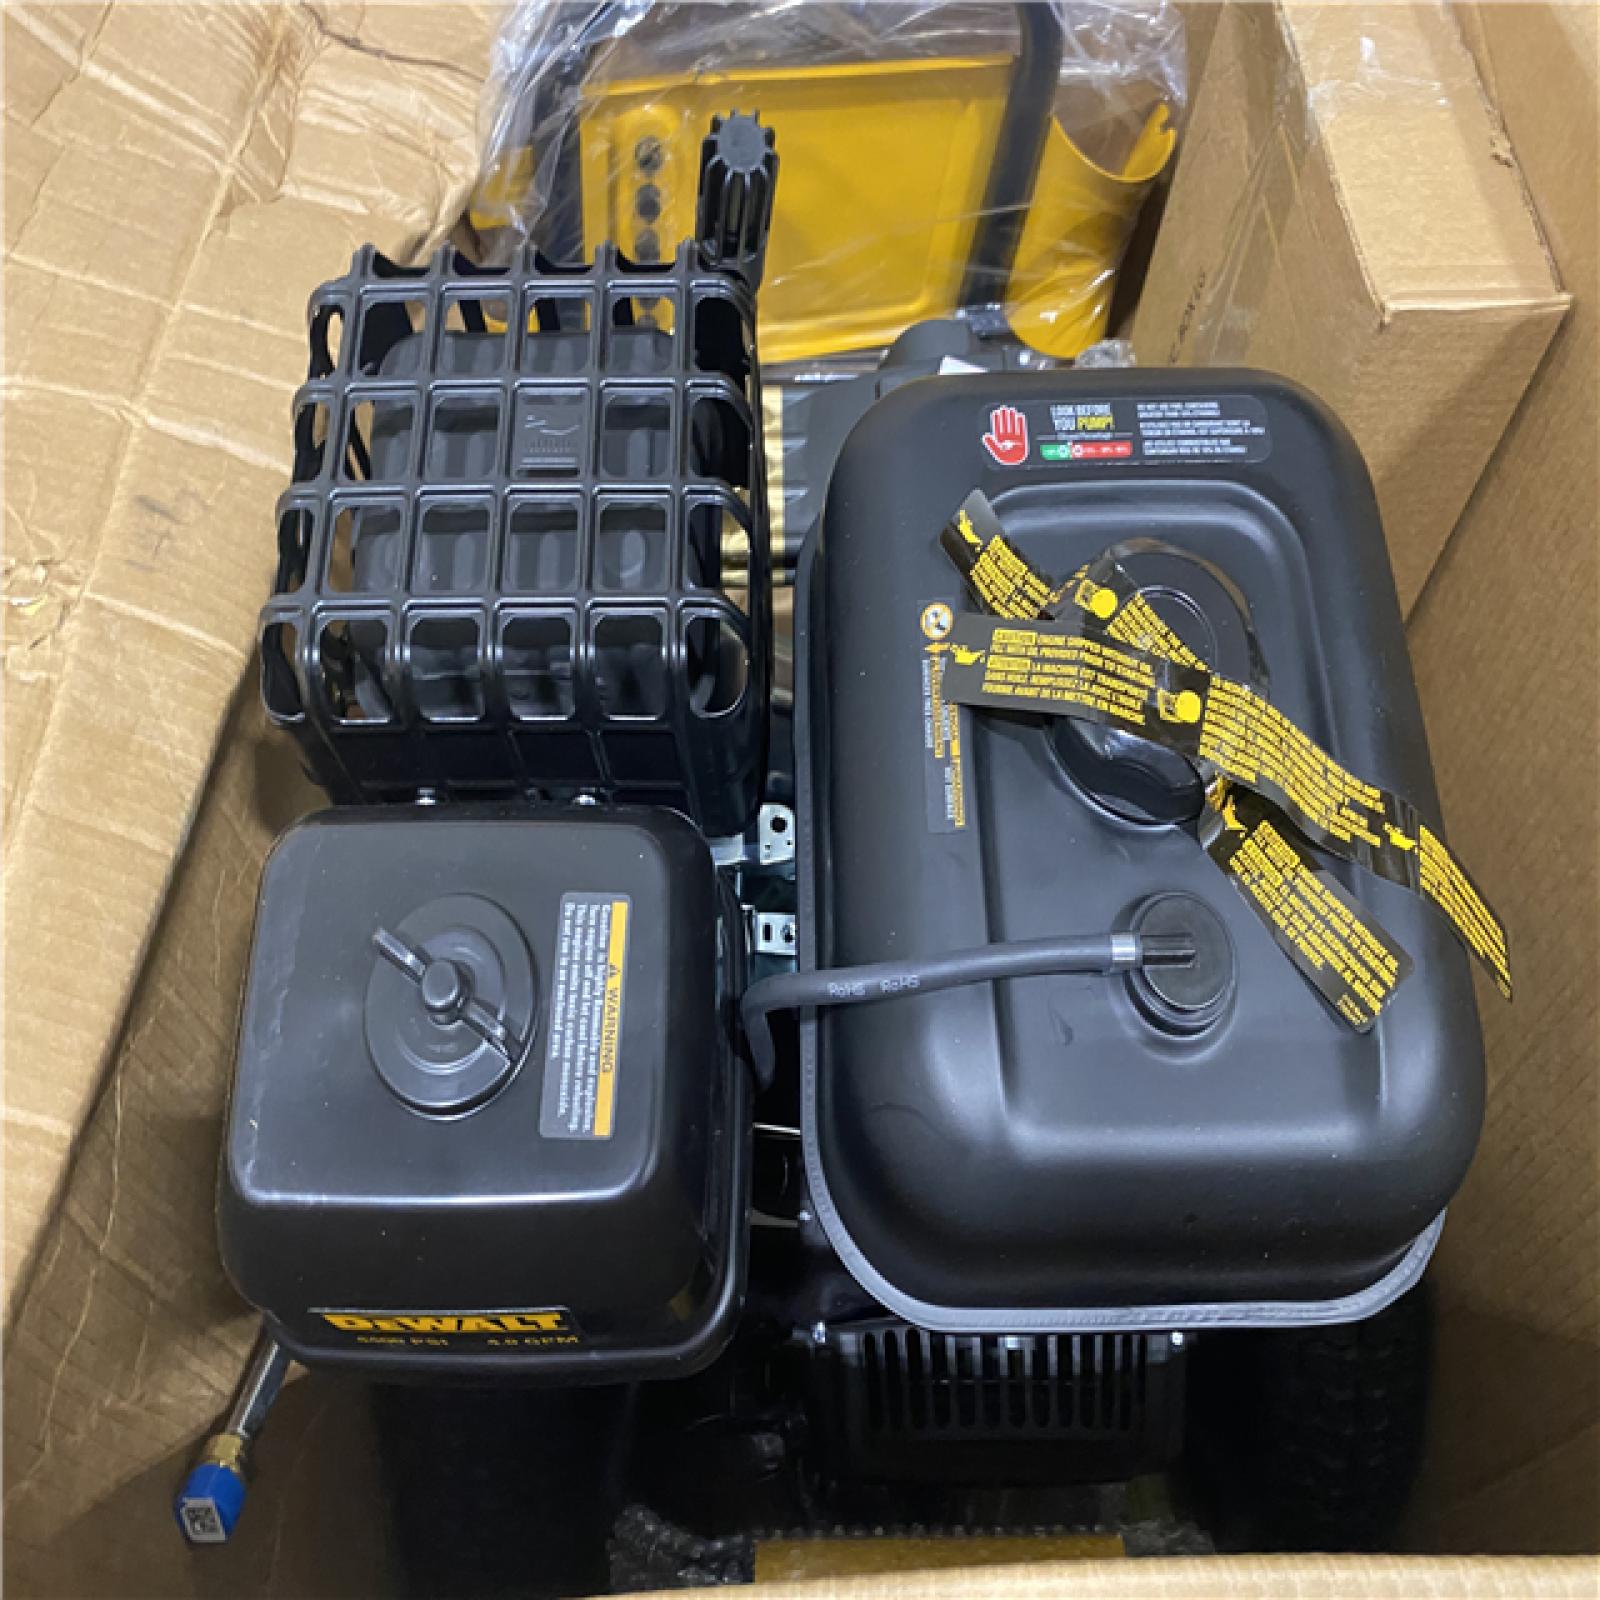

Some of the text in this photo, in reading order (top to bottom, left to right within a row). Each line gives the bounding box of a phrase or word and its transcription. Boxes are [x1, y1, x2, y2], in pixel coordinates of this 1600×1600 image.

[1050, 403, 1111, 416] LOOK BEFORE
[1054, 415, 1114, 431] YOU PUMP!
[600, 987, 618, 1073] WARNING
[323, 1313, 567, 1332] DEWALT
